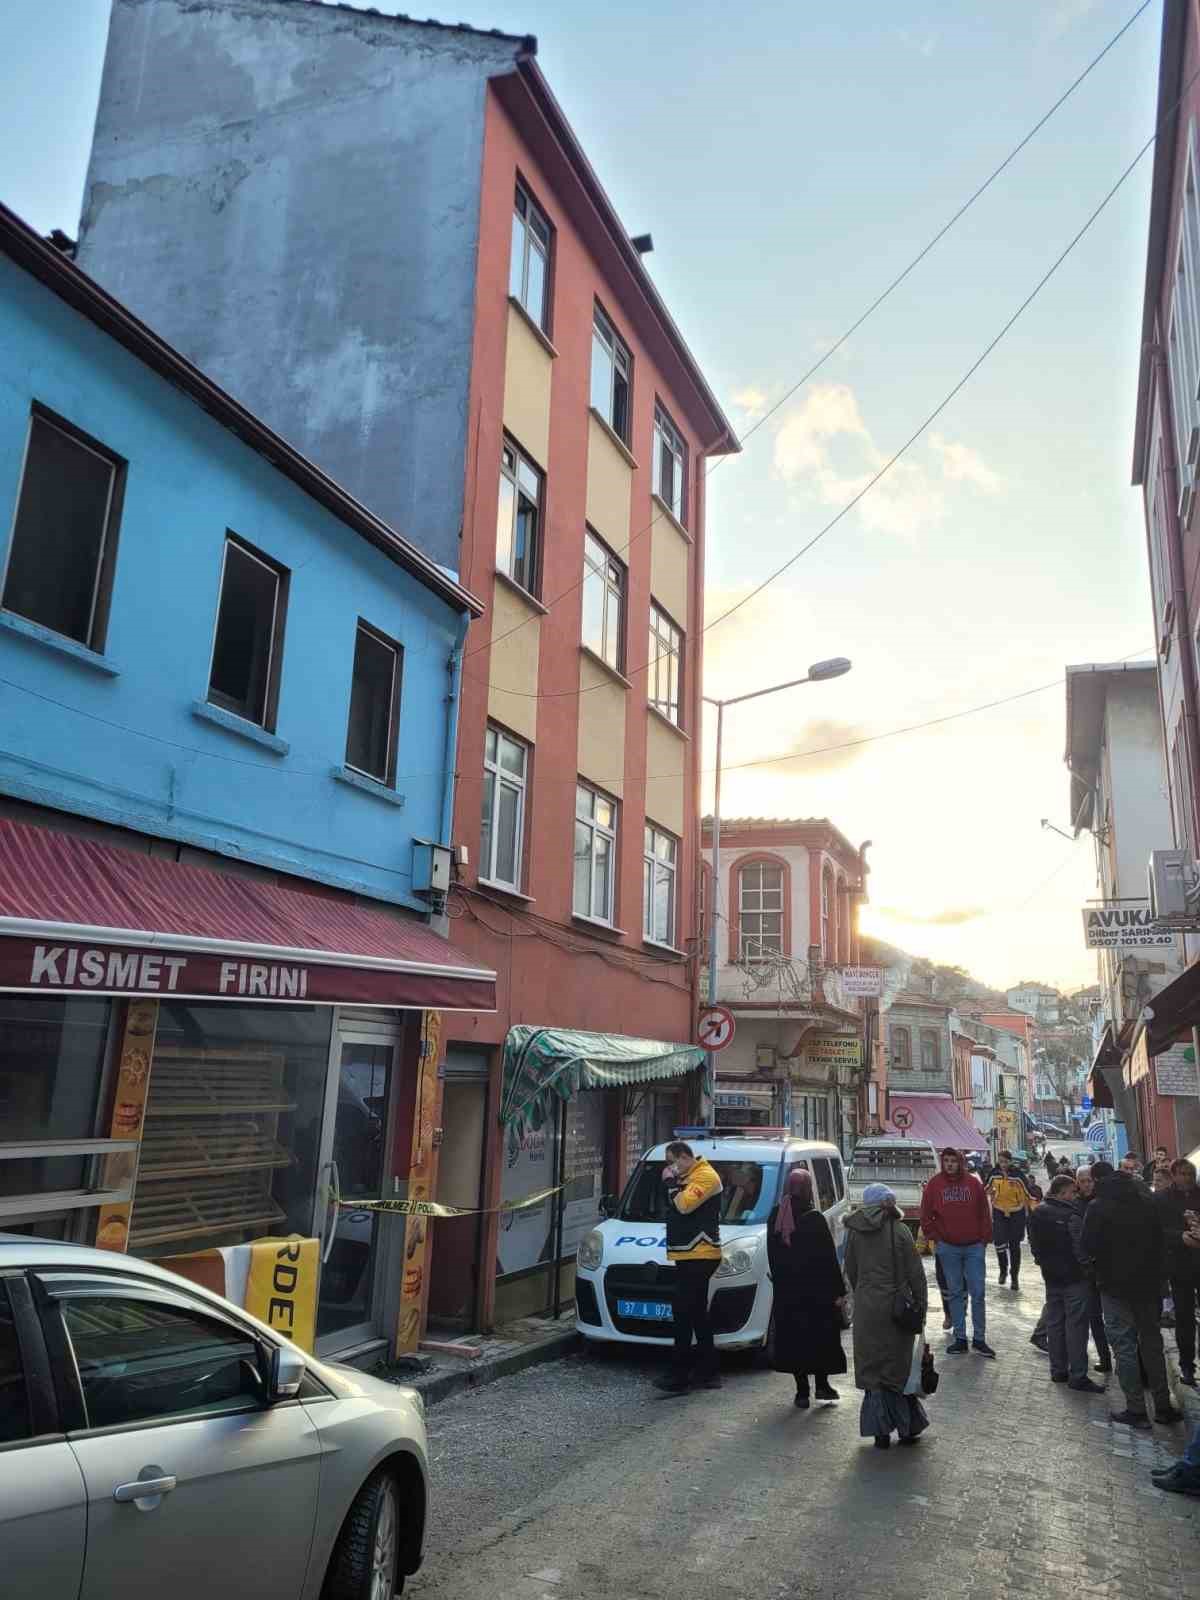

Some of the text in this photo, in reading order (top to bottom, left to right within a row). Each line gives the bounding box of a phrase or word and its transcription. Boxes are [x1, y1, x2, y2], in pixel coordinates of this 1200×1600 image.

[1088, 910, 1155, 927] AVUKA
[1089, 929, 1119, 938] Dilber
[1090, 938, 1118, 946] 0507
[1140, 937, 1155, 945] 92
[1156, 936, 1172, 944] 40
[30, 945, 308, 998] KISMET FIRINI
[614, 1236, 668, 1248] POL
[623, 1302, 635, 1314] 37
